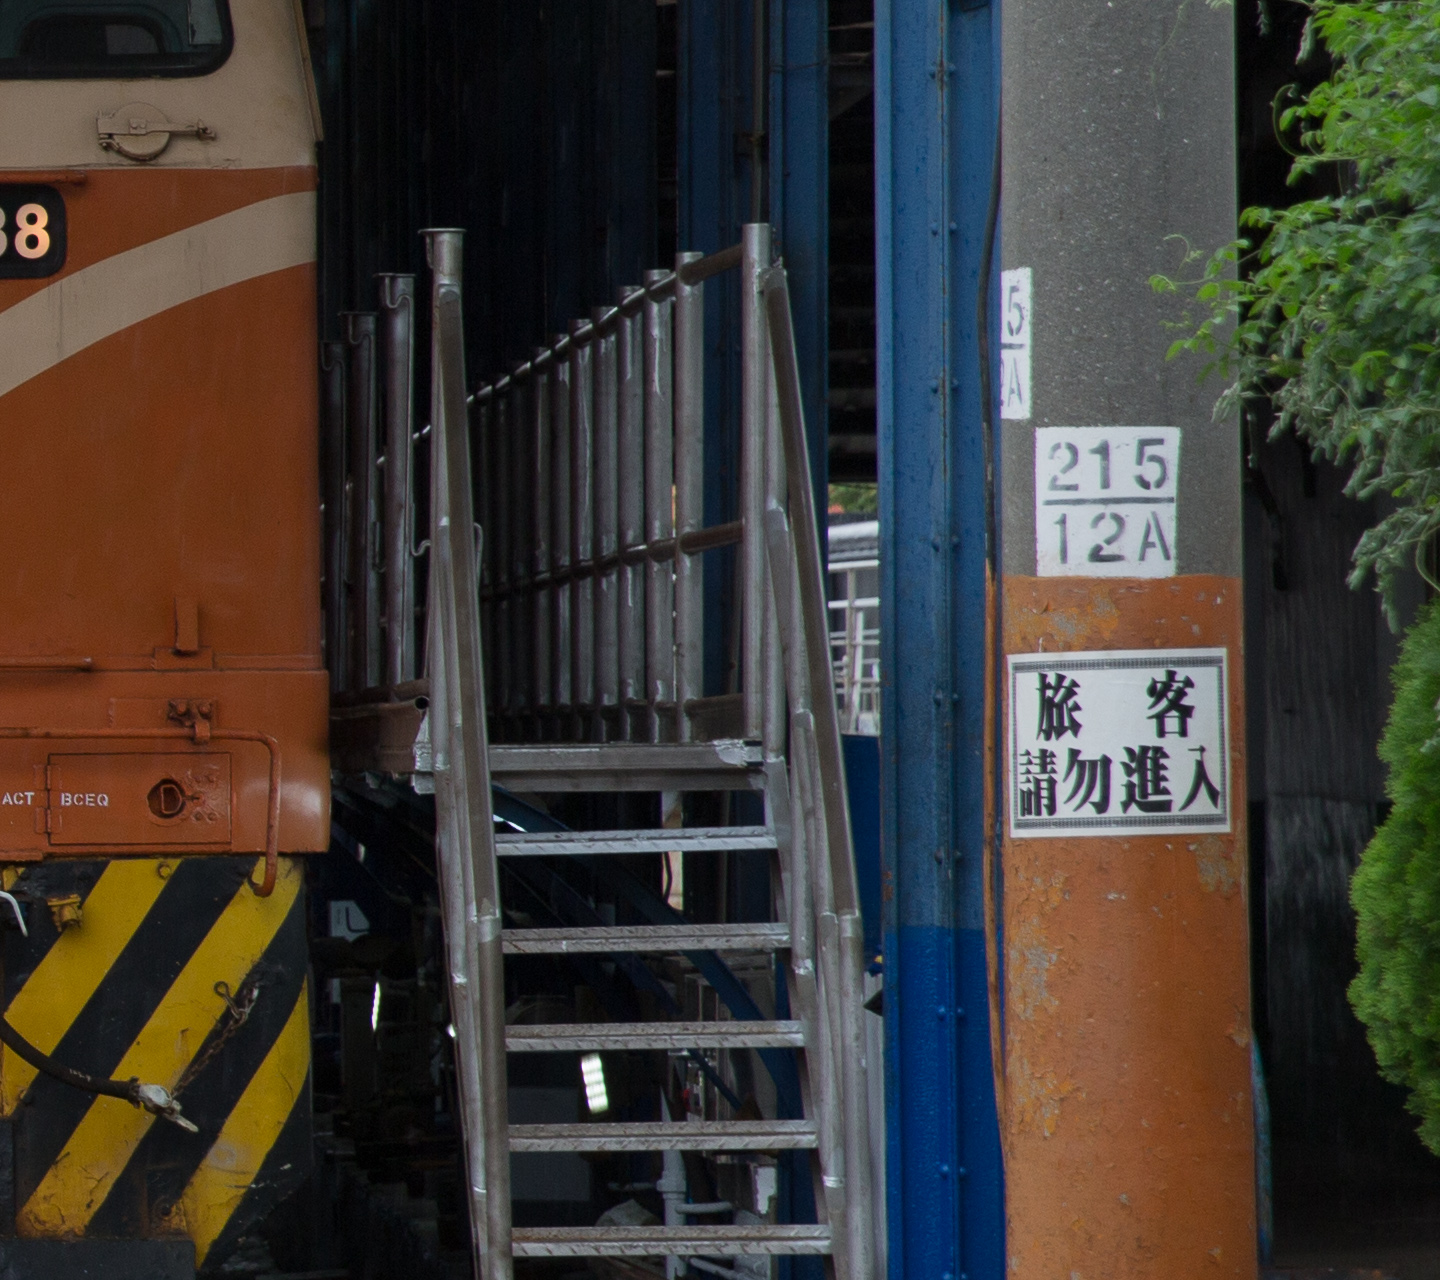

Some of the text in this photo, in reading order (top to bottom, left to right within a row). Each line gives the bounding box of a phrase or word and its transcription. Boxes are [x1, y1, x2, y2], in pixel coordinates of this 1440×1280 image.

[1047, 437, 1169, 491] 215
[1053, 511, 1171, 564] 12A
[2, 792, 35, 806] ACT
[60, 793, 109, 807] BCEQ
[1019, 744, 1220, 817] 請勿進入
